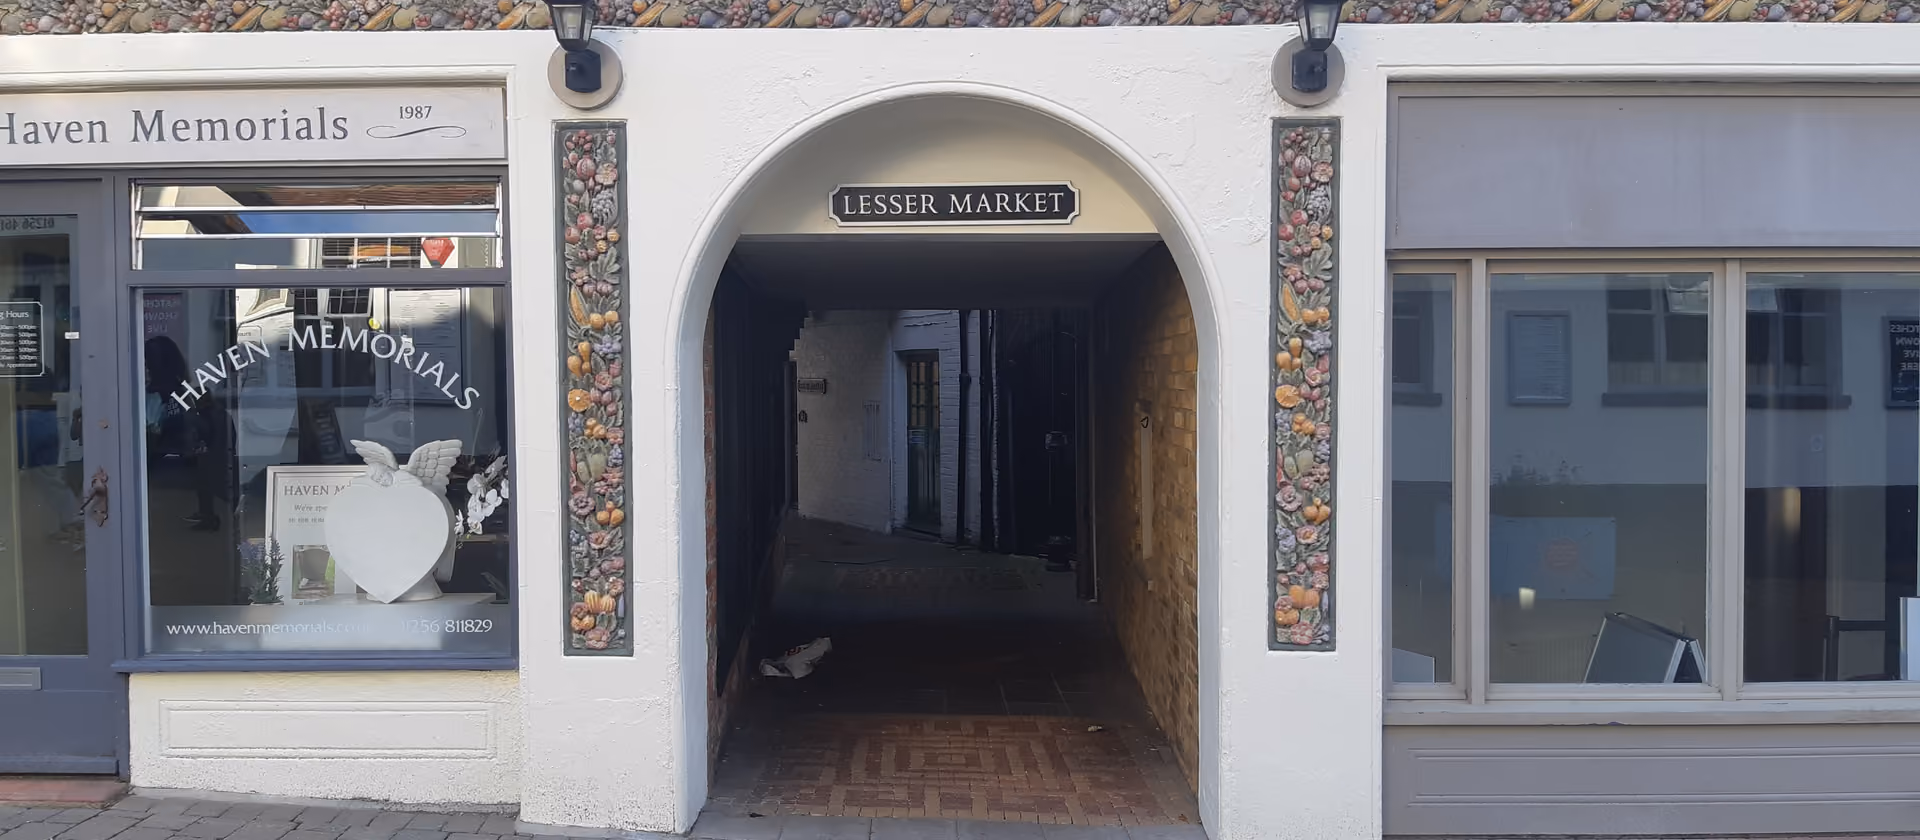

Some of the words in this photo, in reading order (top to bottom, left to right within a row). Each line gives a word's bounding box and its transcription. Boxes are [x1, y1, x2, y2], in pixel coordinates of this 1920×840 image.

[399, 105, 433, 120] 1987
[0, 112, 109, 145] Haven
[129, 106, 350, 144] Memorials
[843, 194, 939, 215] LESSER
[948, 191, 1065, 214] MARKET
[170, 337, 270, 412] HAVEN
[287, 324, 481, 410] MEMORIALS
[284, 485, 329, 496] HAVEN
[445, 618, 493, 633] 811829
